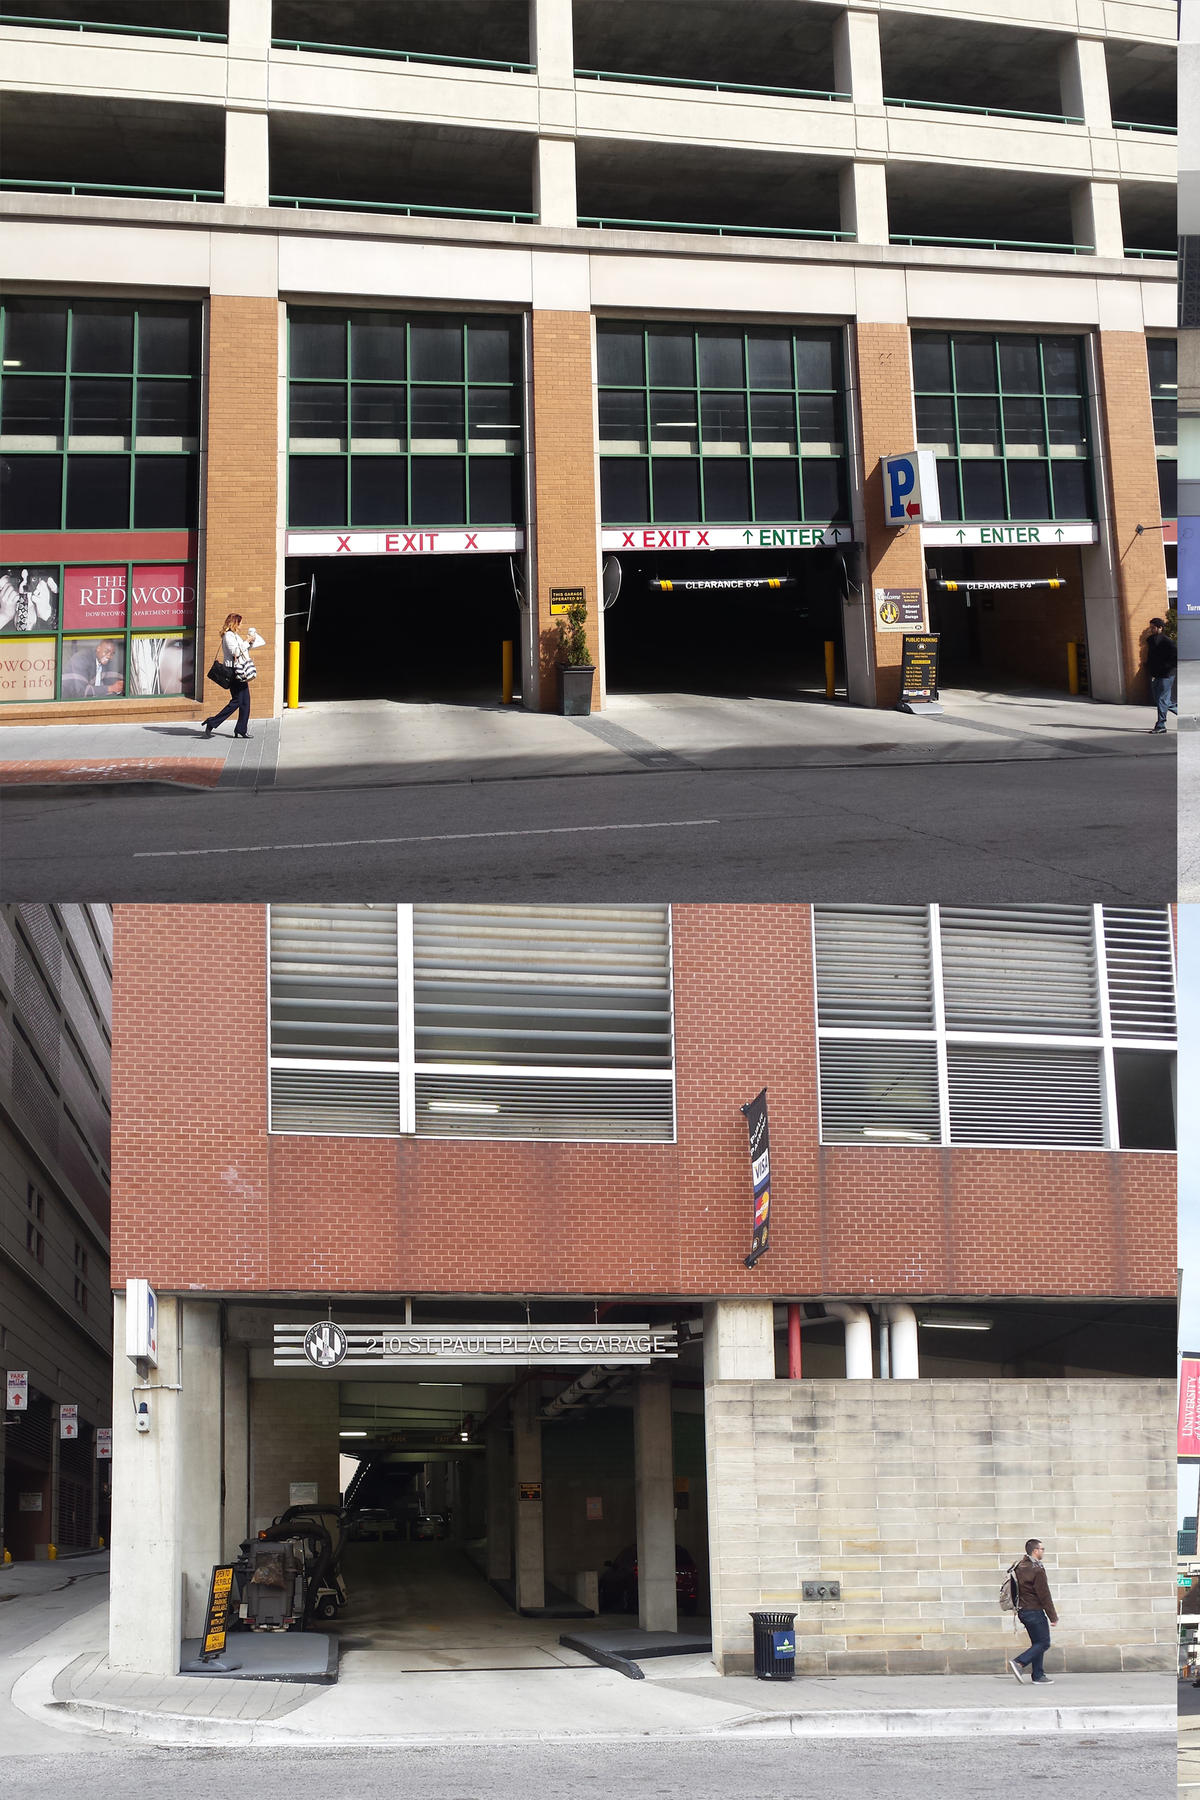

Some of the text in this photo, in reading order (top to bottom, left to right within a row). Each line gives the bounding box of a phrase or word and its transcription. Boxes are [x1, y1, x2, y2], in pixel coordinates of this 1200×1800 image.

[887, 458, 915, 518] P
[385, 533, 439, 552] EXIT
[643, 530, 690, 548] EXIT
[759, 529, 825, 546] ENTER
[980, 527, 1041, 543] ENTER
[93, 575, 126, 587] THE
[685, 579, 764, 590] CLEARANCE 6'4"
[966, 581, 1019, 590] CLEARANCE
[80, 586, 195, 606] REDWOOD
[0, 658, 56, 672] WOOD
[23, 674, 53, 688] info
[754, 1155, 768, 1179] VISA
[365, 1336, 401, 1354] 210
[441, 1336, 493, 1353] PAUL
[500, 1335, 569, 1353] PLACE
[578, 1335, 666, 1353] GARAGE
[1182, 1376, 1196, 1437] UNIVERSITY
